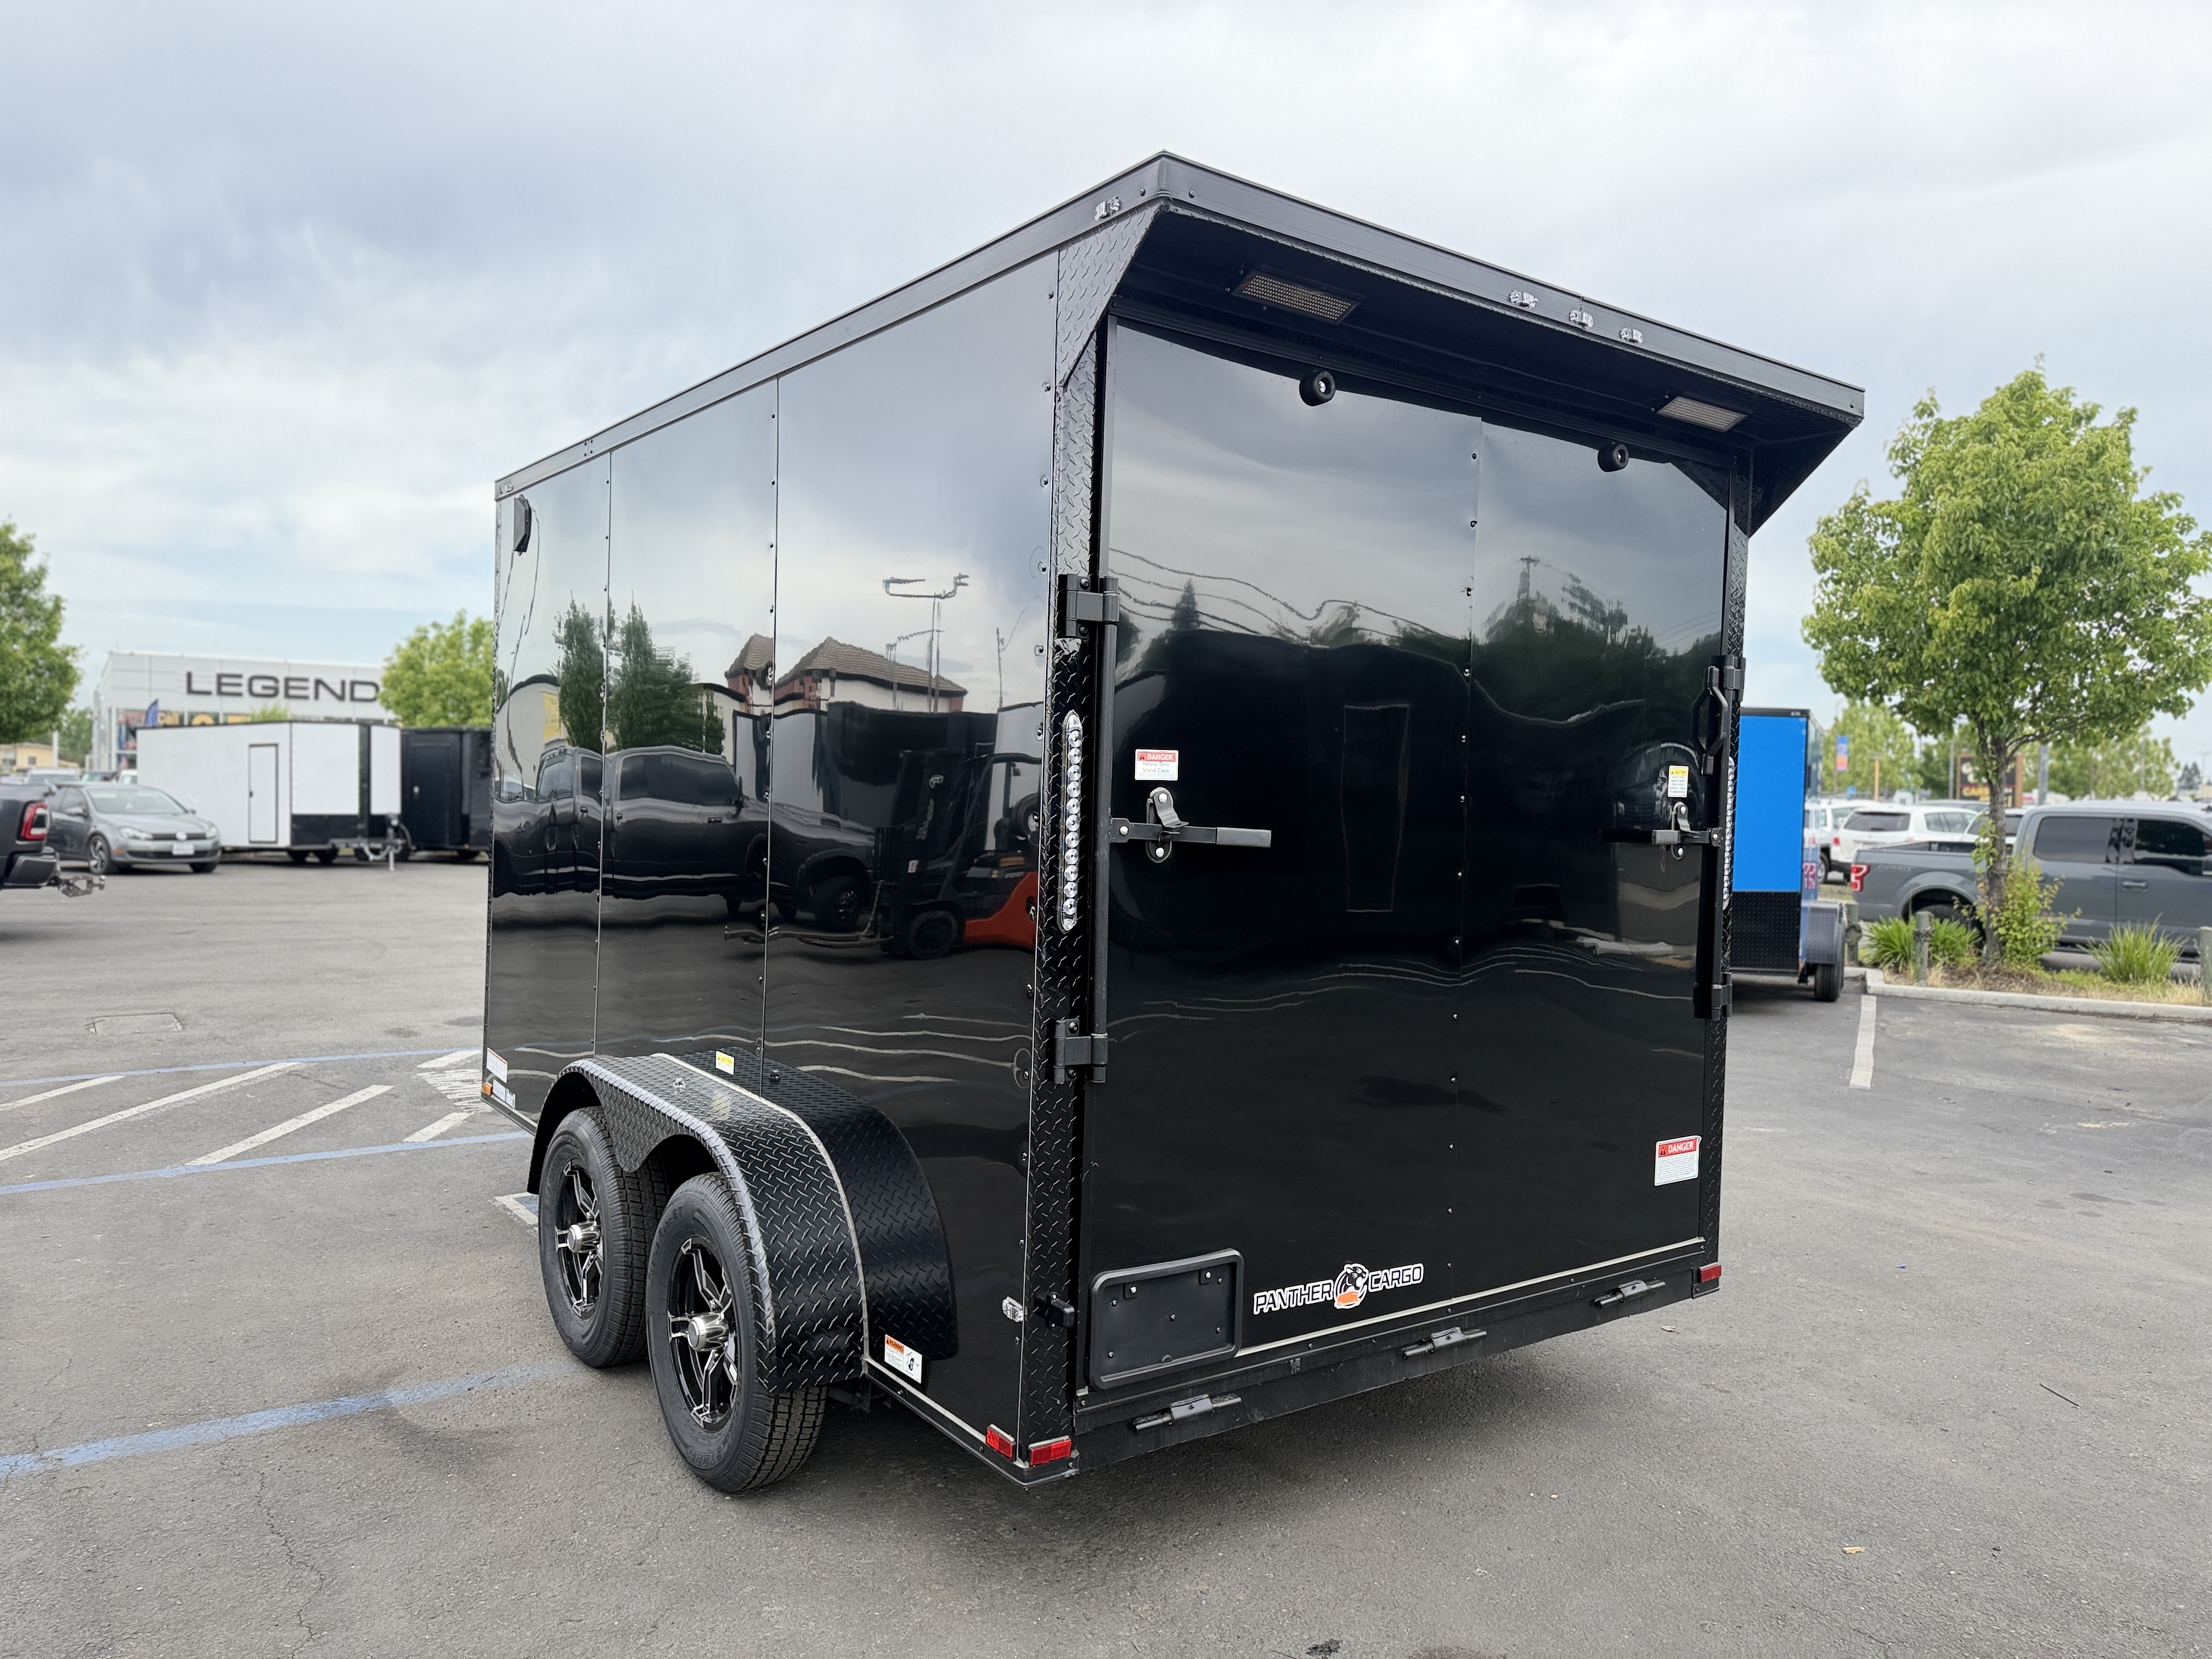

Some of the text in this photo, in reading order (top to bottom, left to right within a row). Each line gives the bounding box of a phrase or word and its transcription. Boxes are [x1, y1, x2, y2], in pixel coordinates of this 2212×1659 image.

[186, 671, 380, 702] LEGEND
[1668, 1141, 1694, 1153] DANGER
[1253, 1263, 1424, 1315] PANTHER CARGO
